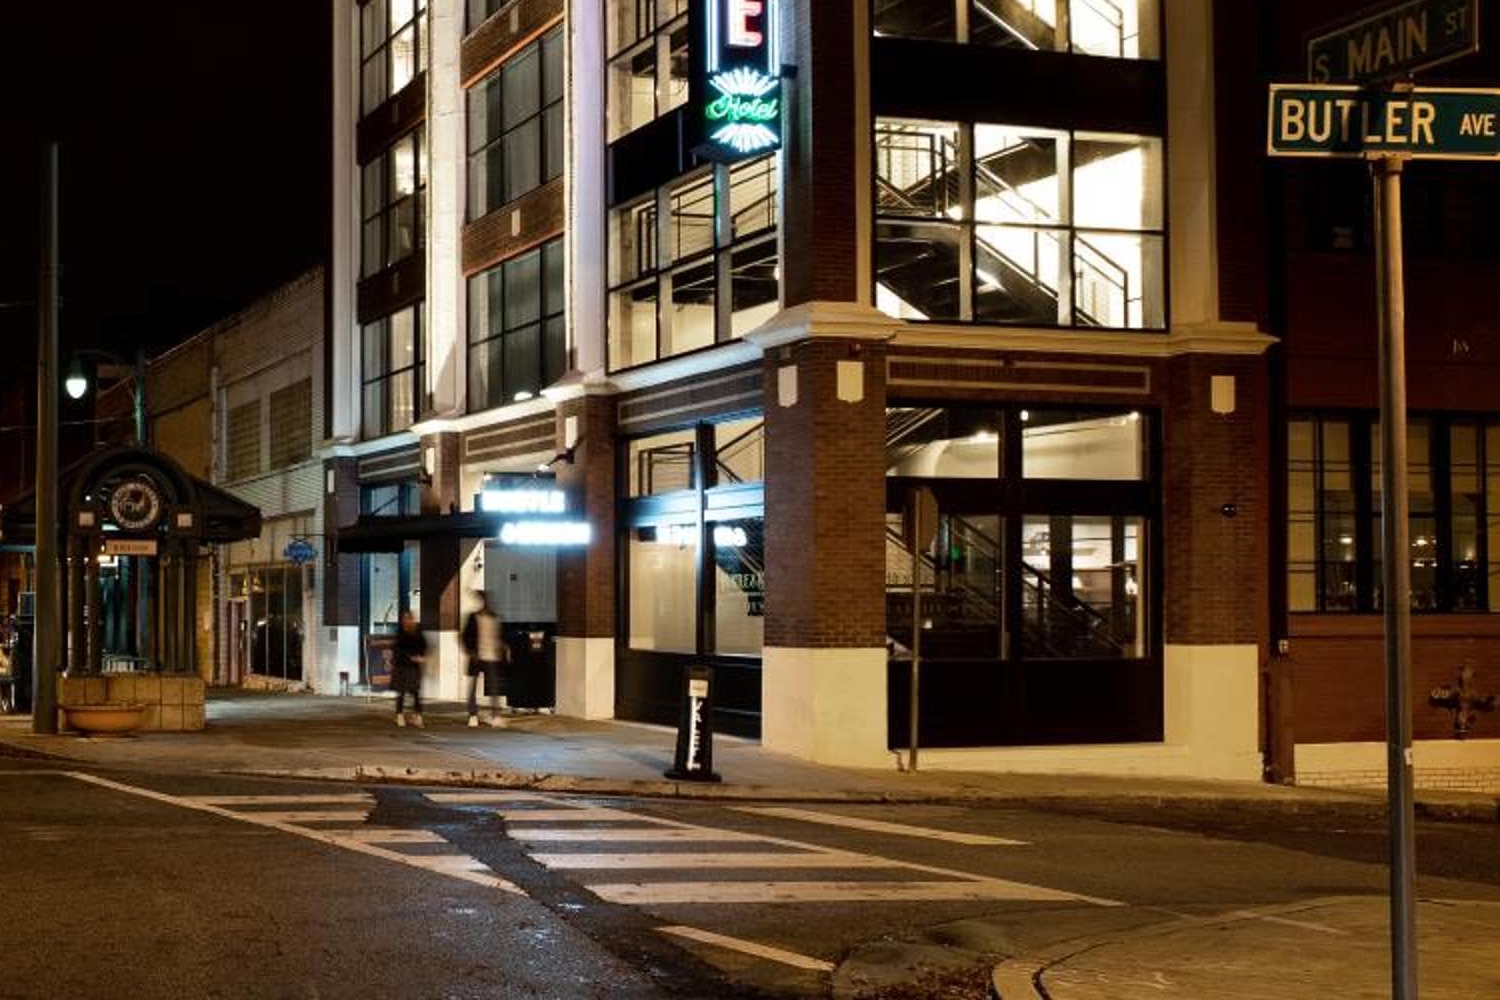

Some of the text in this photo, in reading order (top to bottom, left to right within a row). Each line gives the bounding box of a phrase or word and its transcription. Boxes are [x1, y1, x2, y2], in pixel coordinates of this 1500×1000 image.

[1315, 6, 1468, 83] S MAIN ST
[708, 95, 778, 119] Hotel
[1280, 98, 1496, 145] BUTLER AVE
